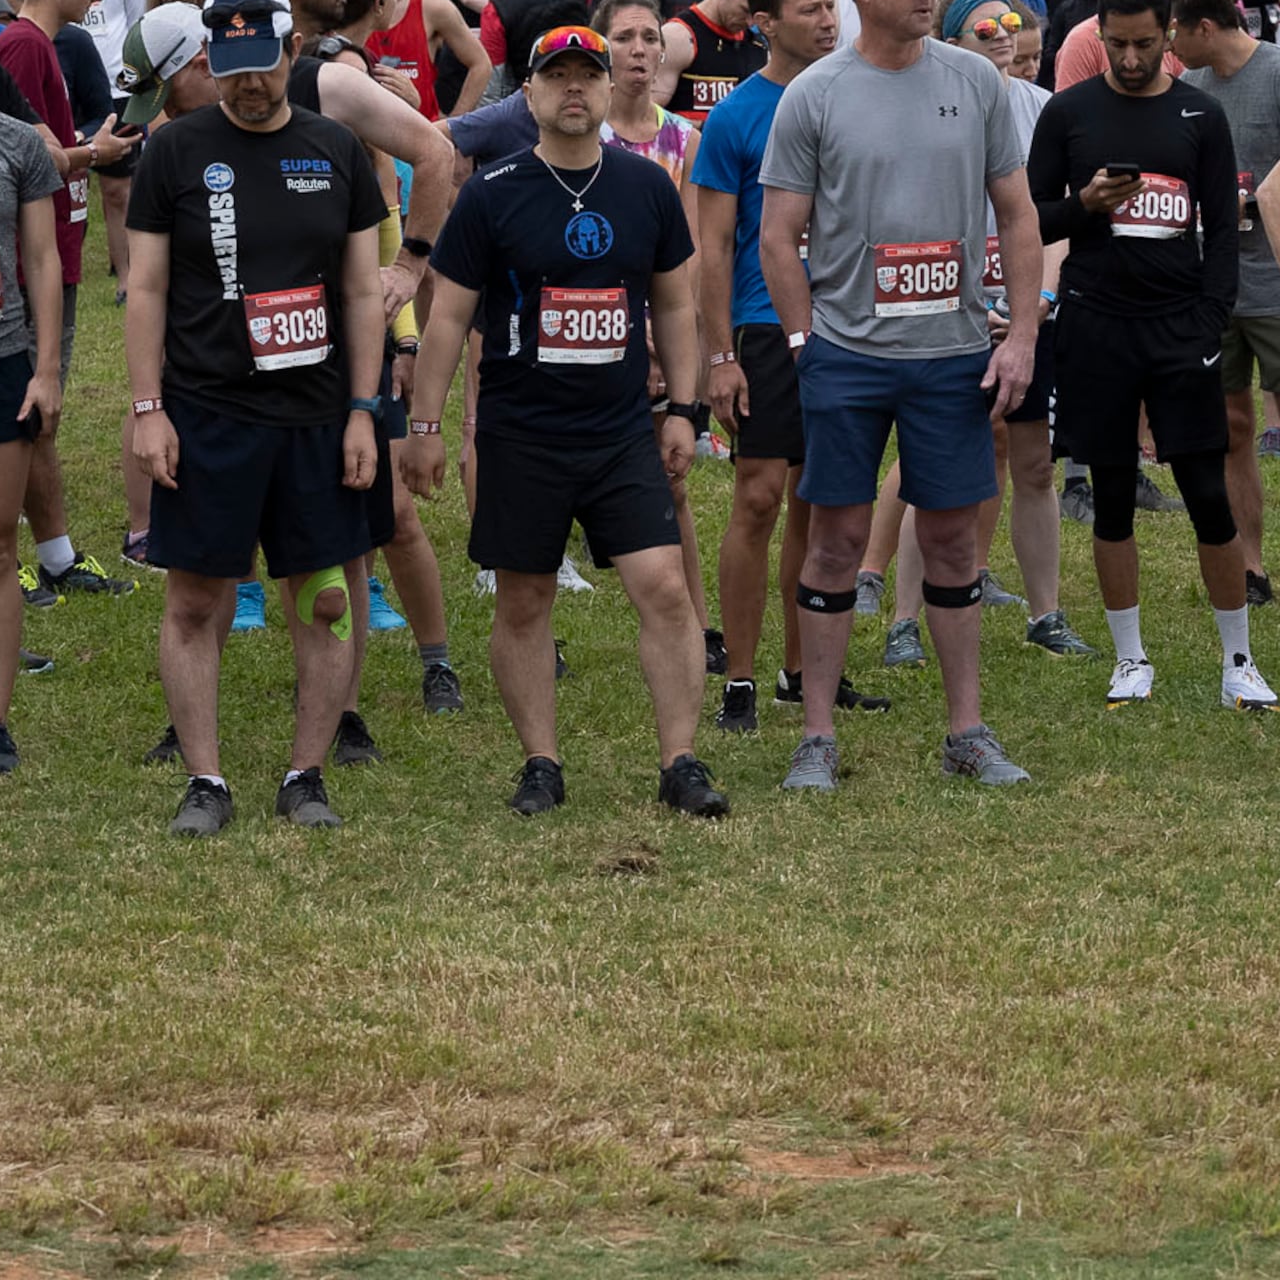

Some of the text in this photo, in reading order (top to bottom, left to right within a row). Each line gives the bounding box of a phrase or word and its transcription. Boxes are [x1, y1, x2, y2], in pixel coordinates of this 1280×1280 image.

[280, 159, 332, 172] SUPER
[286, 177, 331, 191] Rakuten
[1129, 191, 1188, 222] 3090
[208, 192, 239, 301] SPARTAN
[899, 260, 960, 295] 3058
[273, 306, 327, 346] 3039
[563, 309, 627, 341] 3038
